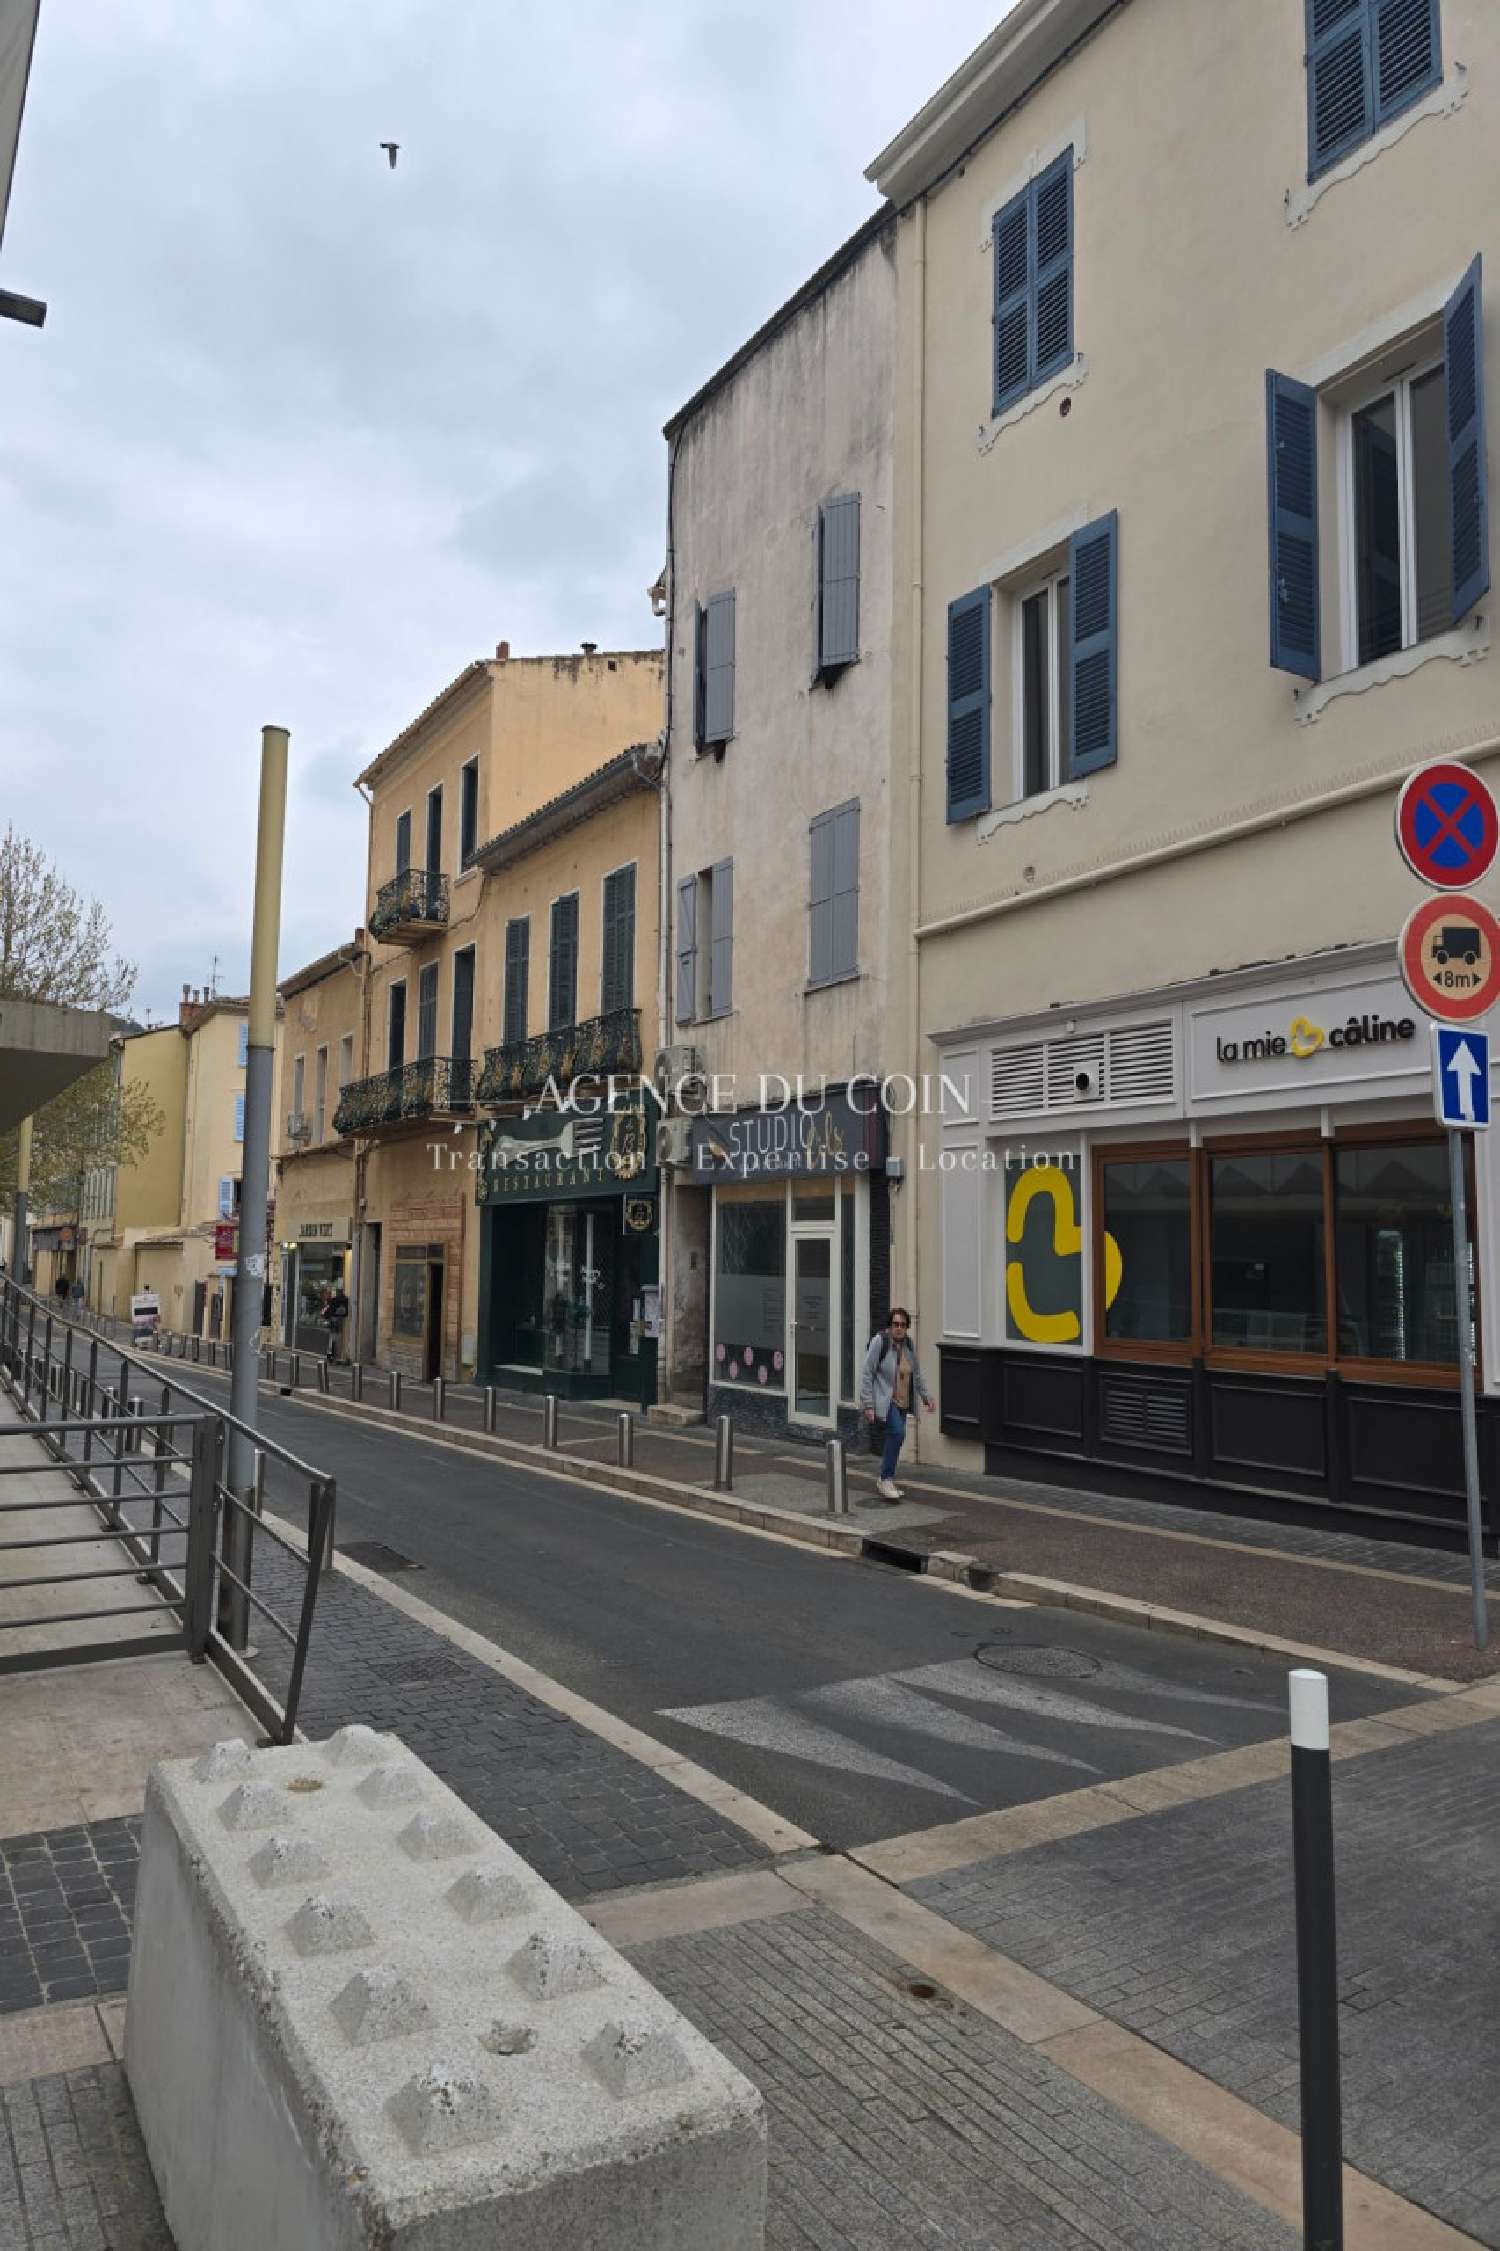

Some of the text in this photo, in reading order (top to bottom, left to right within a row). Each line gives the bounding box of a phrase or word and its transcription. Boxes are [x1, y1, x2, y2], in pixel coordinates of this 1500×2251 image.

[1444, 974, 1471, 988] 8m
[1216, 1014, 1416, 1062] la mie câline
[730, 1112, 813, 1157] STUDIO
